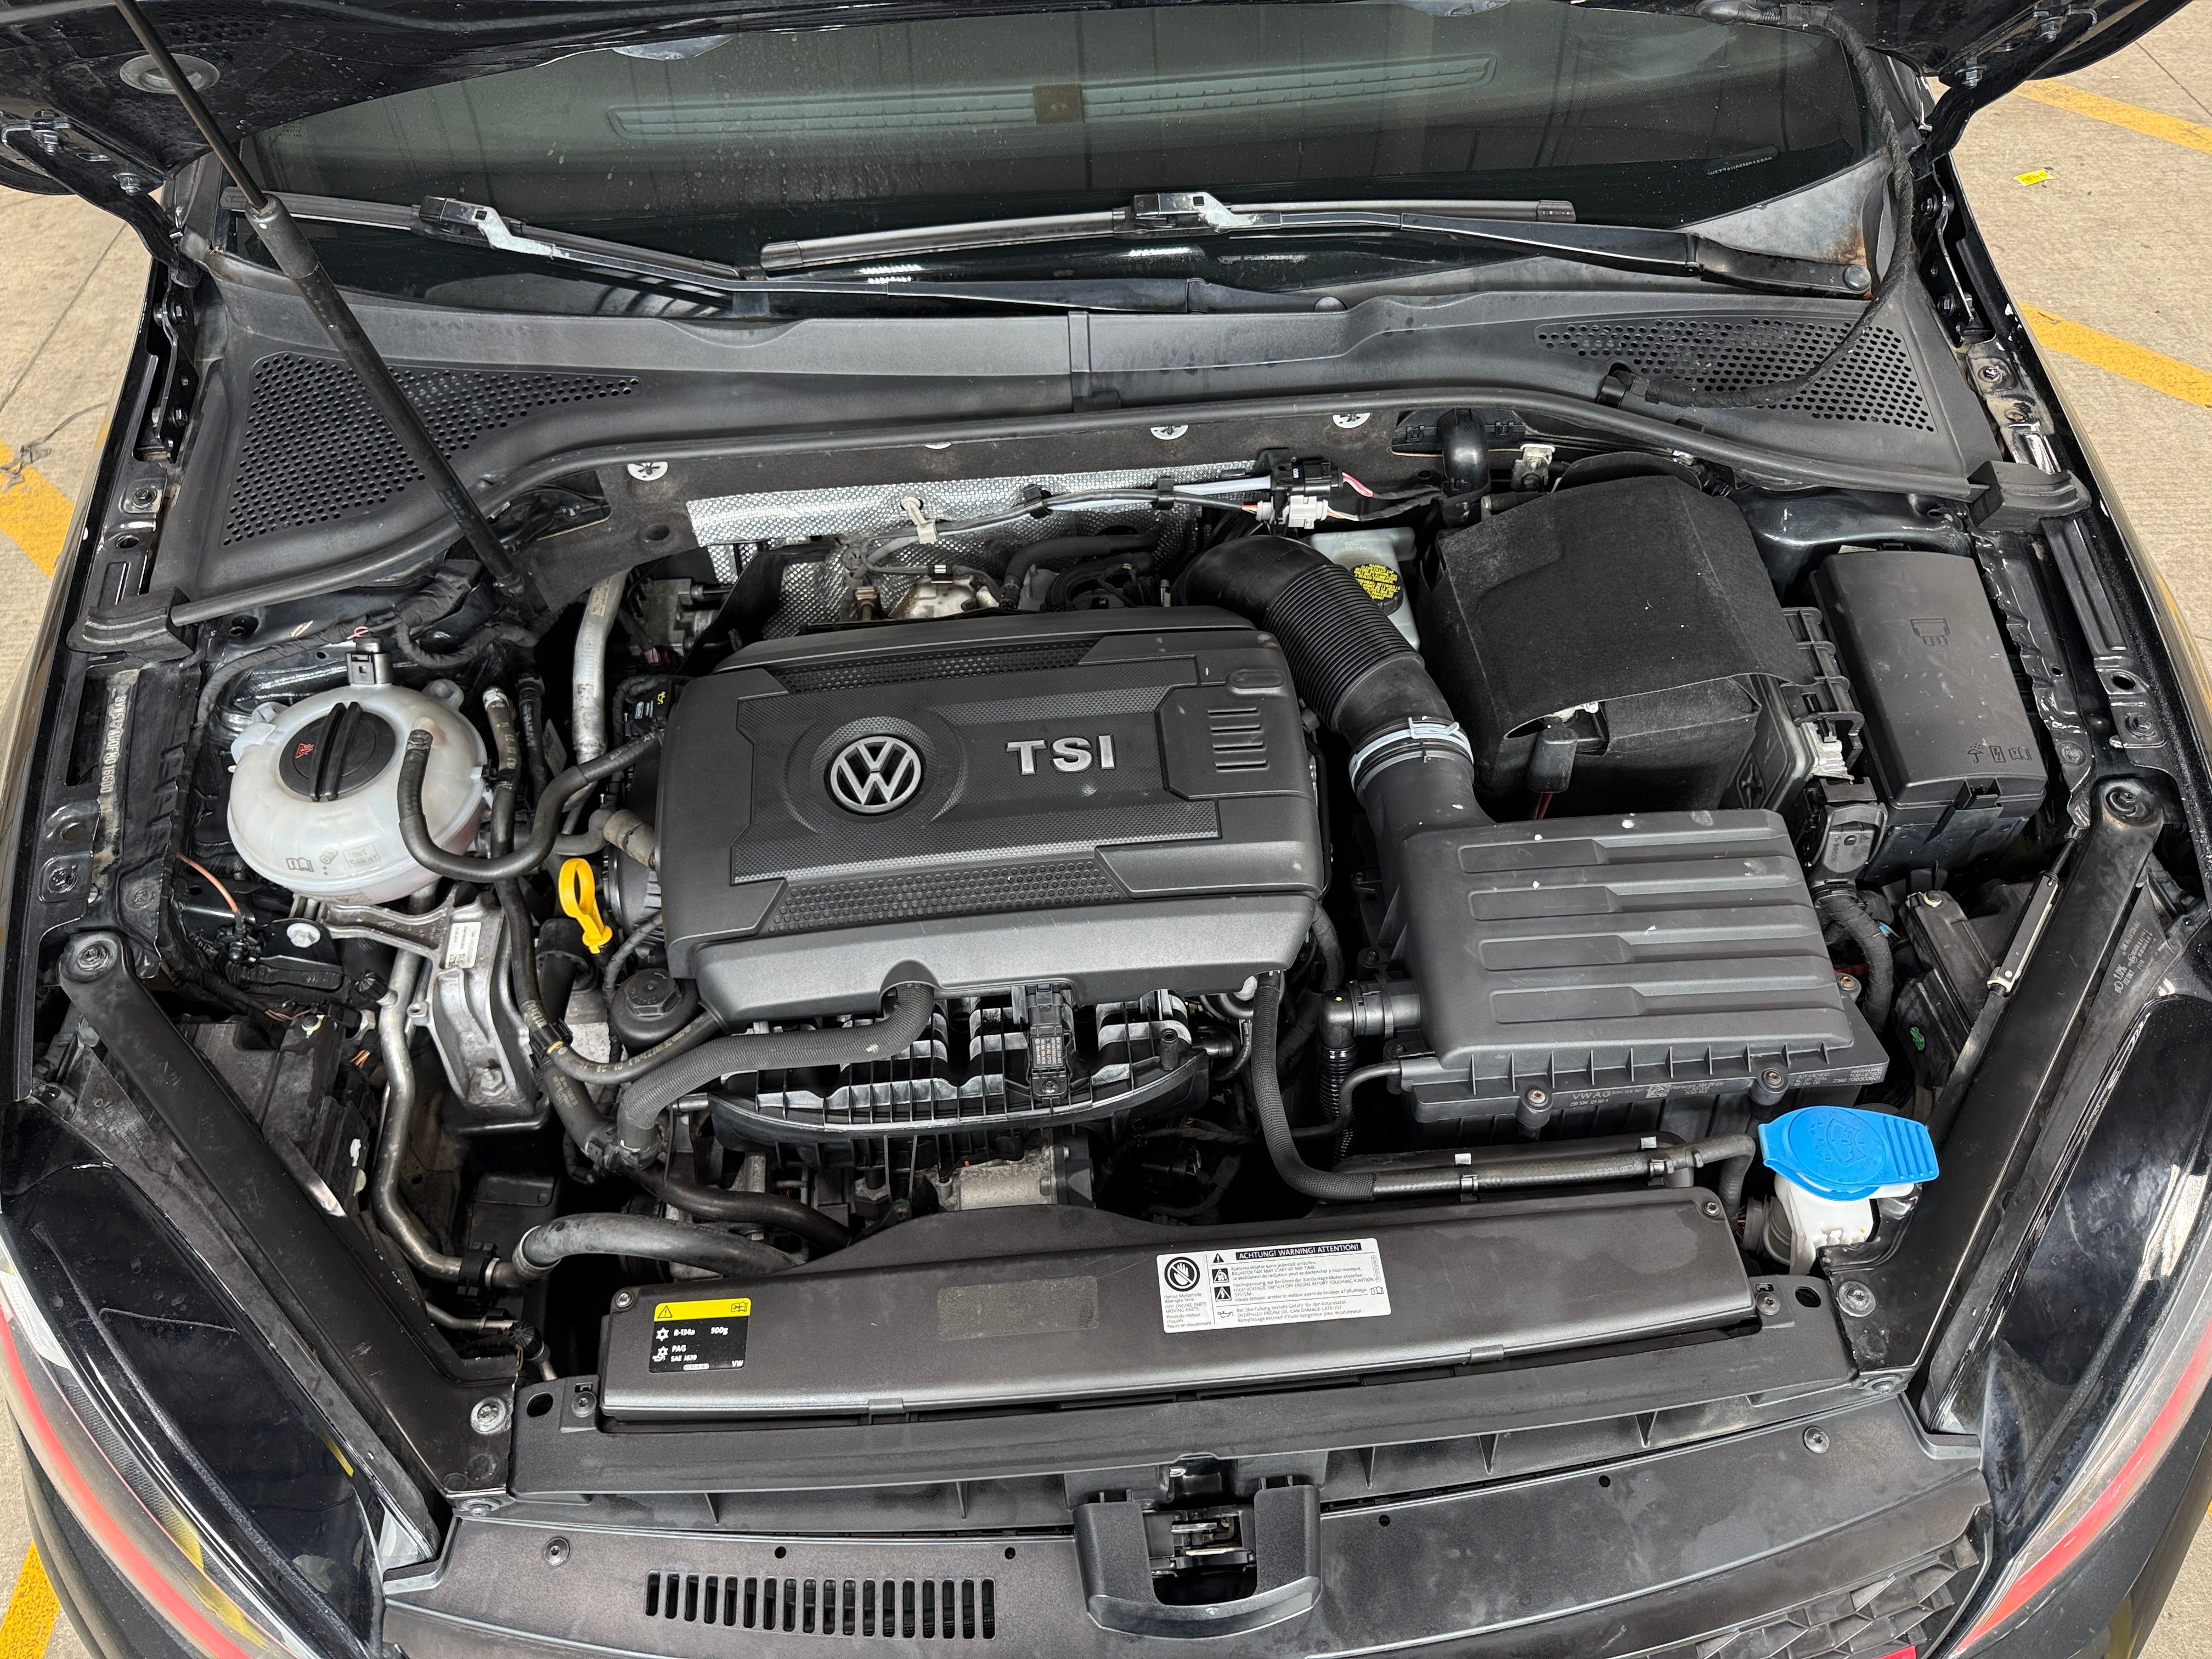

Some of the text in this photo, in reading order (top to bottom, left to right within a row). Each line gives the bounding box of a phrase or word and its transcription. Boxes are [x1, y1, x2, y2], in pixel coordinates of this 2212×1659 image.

[1006, 735, 1116, 776] TSI
[352, 849, 367, 858] mit
[349, 854, 379, 867] Silikat
[1572, 1092, 1593, 1100] VW
[1239, 1243, 1359, 1260] ACHTUNG! WARNING! ATTENTION!
[673, 1326, 729, 1336] R-134a 500g
[672, 1344, 687, 1353] PAG
[670, 1355, 682, 1363] SAE
